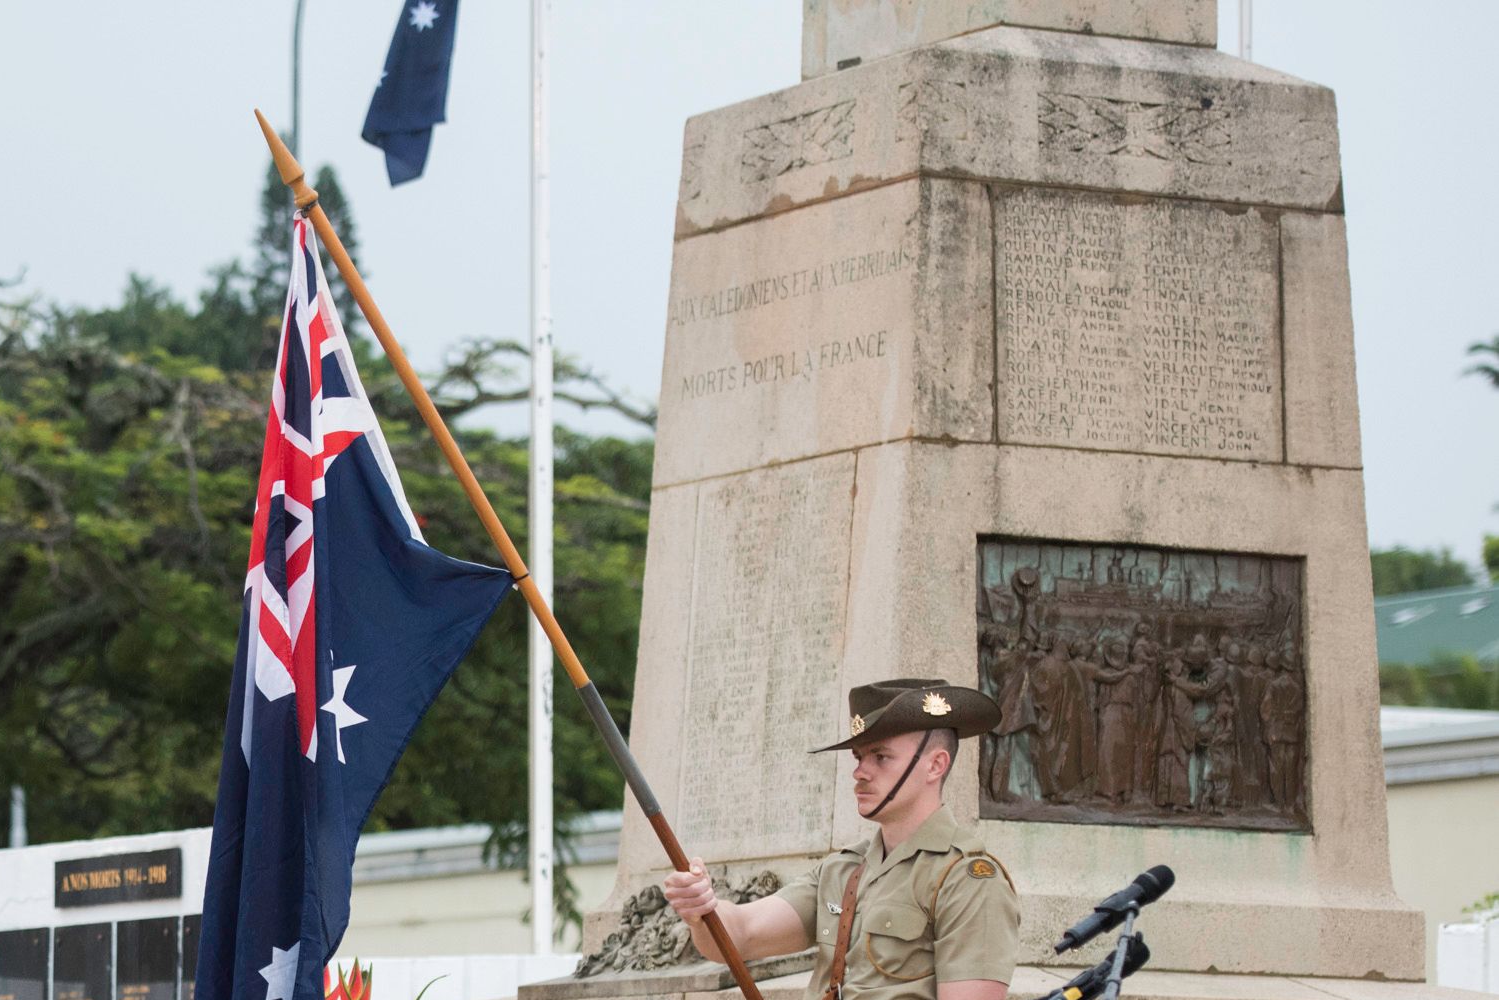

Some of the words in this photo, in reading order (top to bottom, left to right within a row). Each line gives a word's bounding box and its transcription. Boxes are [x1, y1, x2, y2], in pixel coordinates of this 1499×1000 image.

[792, 268, 809, 298] ET
[681, 366, 737, 402] MORTS
[743, 354, 785, 388] POUR
[792, 351, 812, 377] LA
[820, 331, 887, 370] FRANCE
